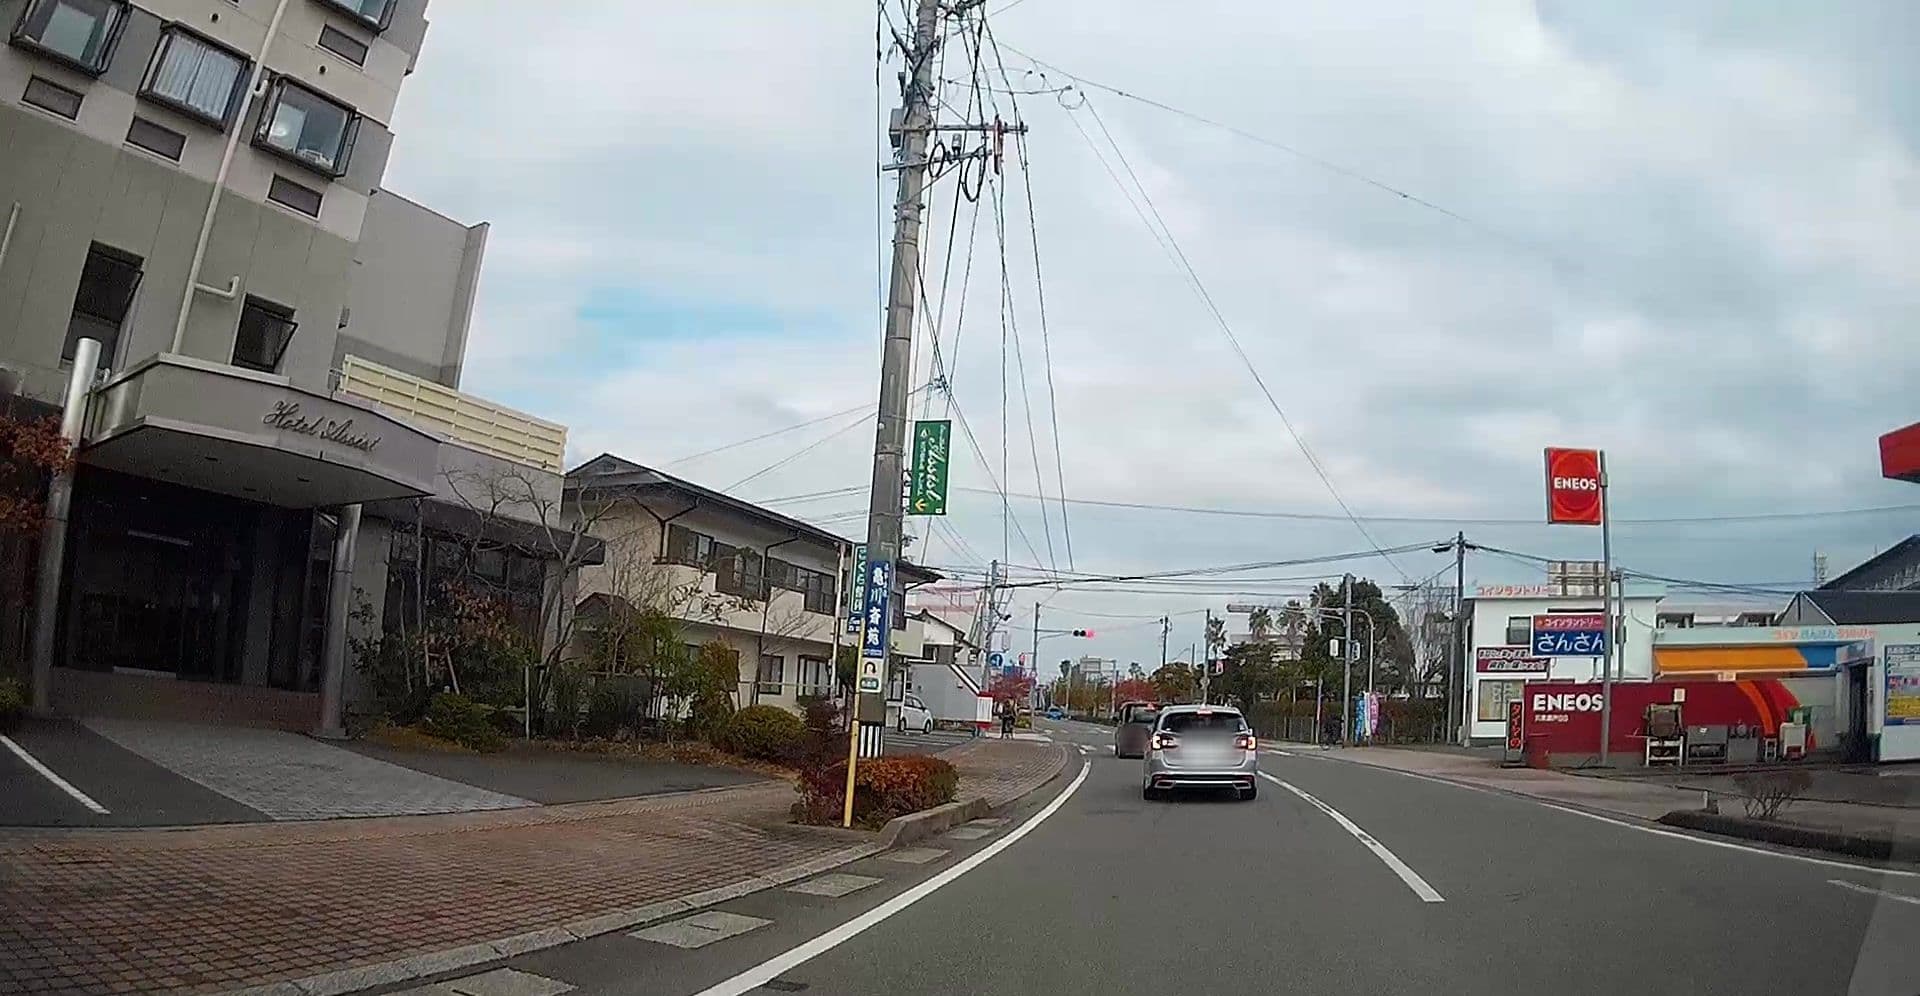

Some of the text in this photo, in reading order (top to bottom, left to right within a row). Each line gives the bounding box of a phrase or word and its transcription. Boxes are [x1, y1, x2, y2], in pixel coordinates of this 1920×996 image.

[262, 400, 382, 451] Hotel Assist
[926, 437, 946, 502] Assist
[1553, 476, 1597, 490] ENEOS
[1538, 632, 1604, 652] さんさん
[1533, 693, 1603, 712] ENEOS
